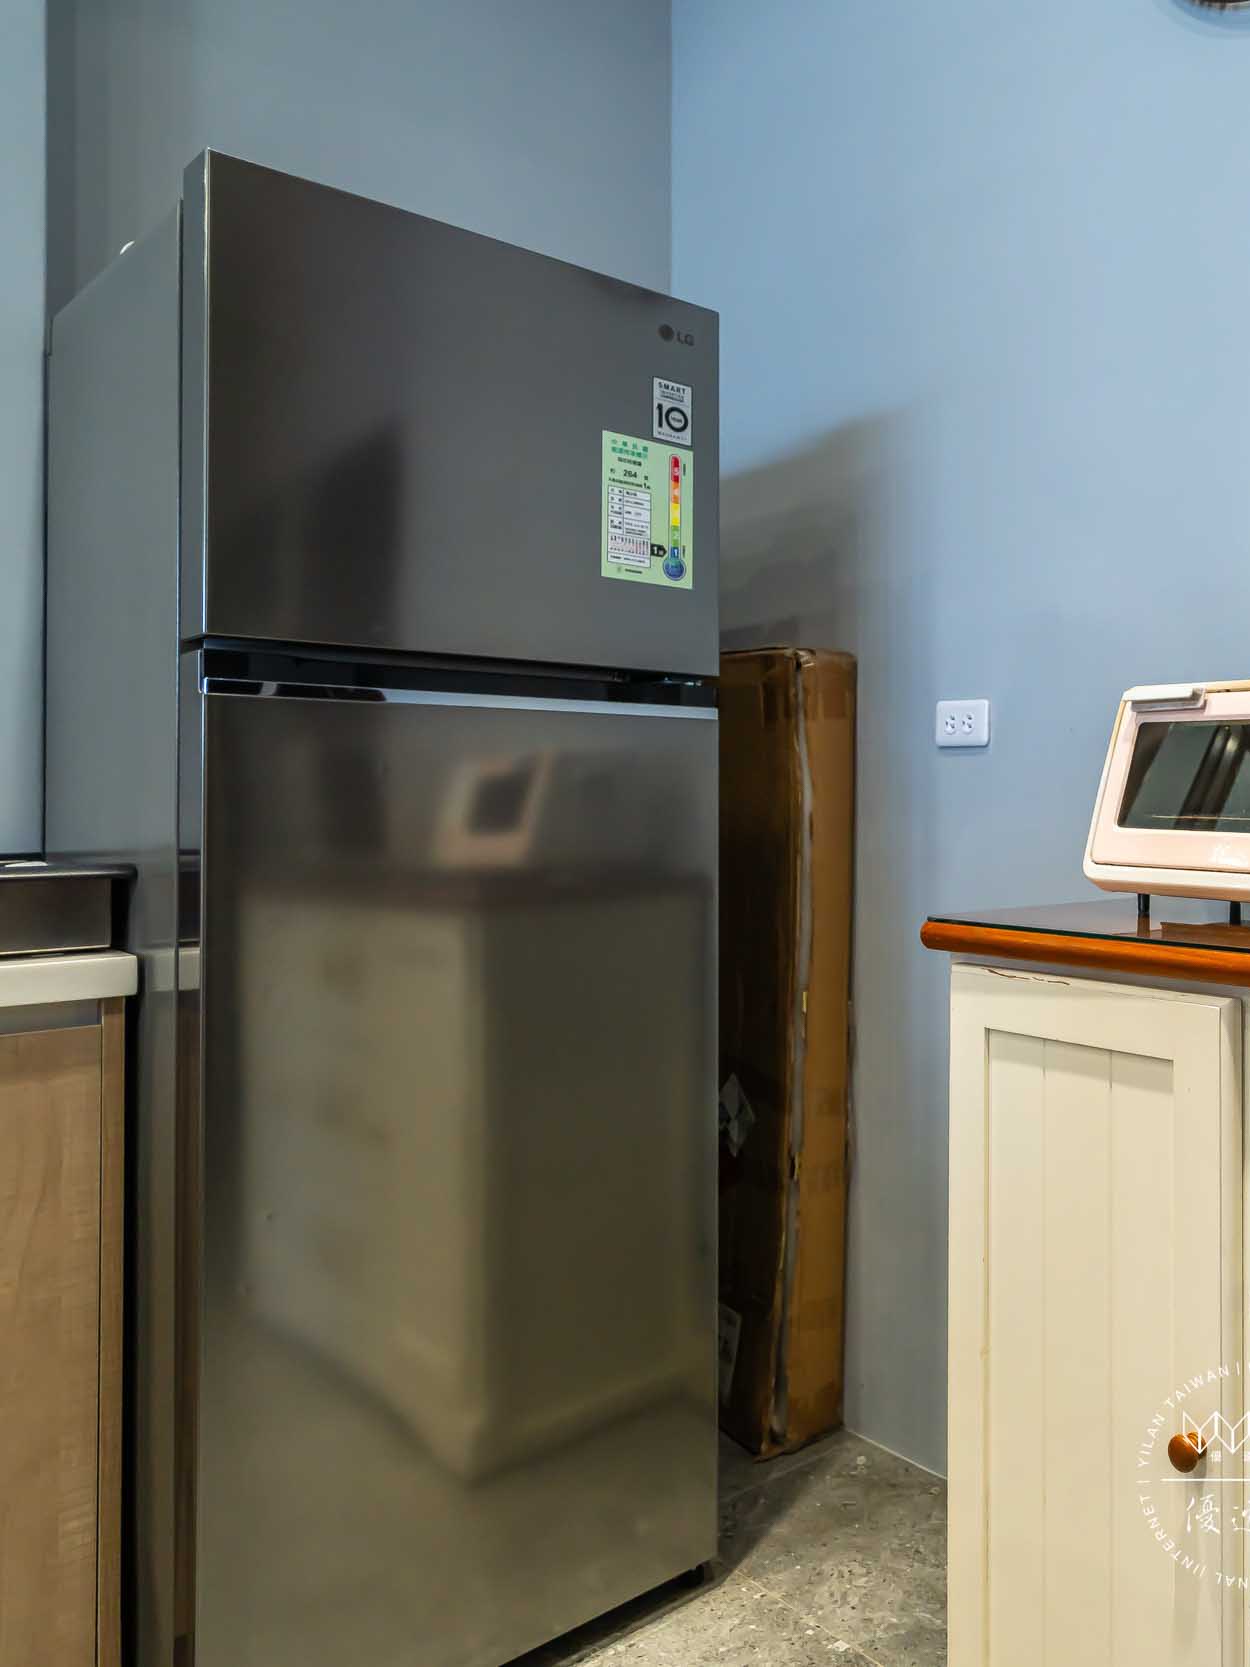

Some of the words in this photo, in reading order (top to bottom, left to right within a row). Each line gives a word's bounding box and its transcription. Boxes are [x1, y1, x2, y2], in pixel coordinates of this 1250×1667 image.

[676, 331, 695, 347] LG
[658, 381, 686, 396] SMART
[657, 403, 689, 433] 10
